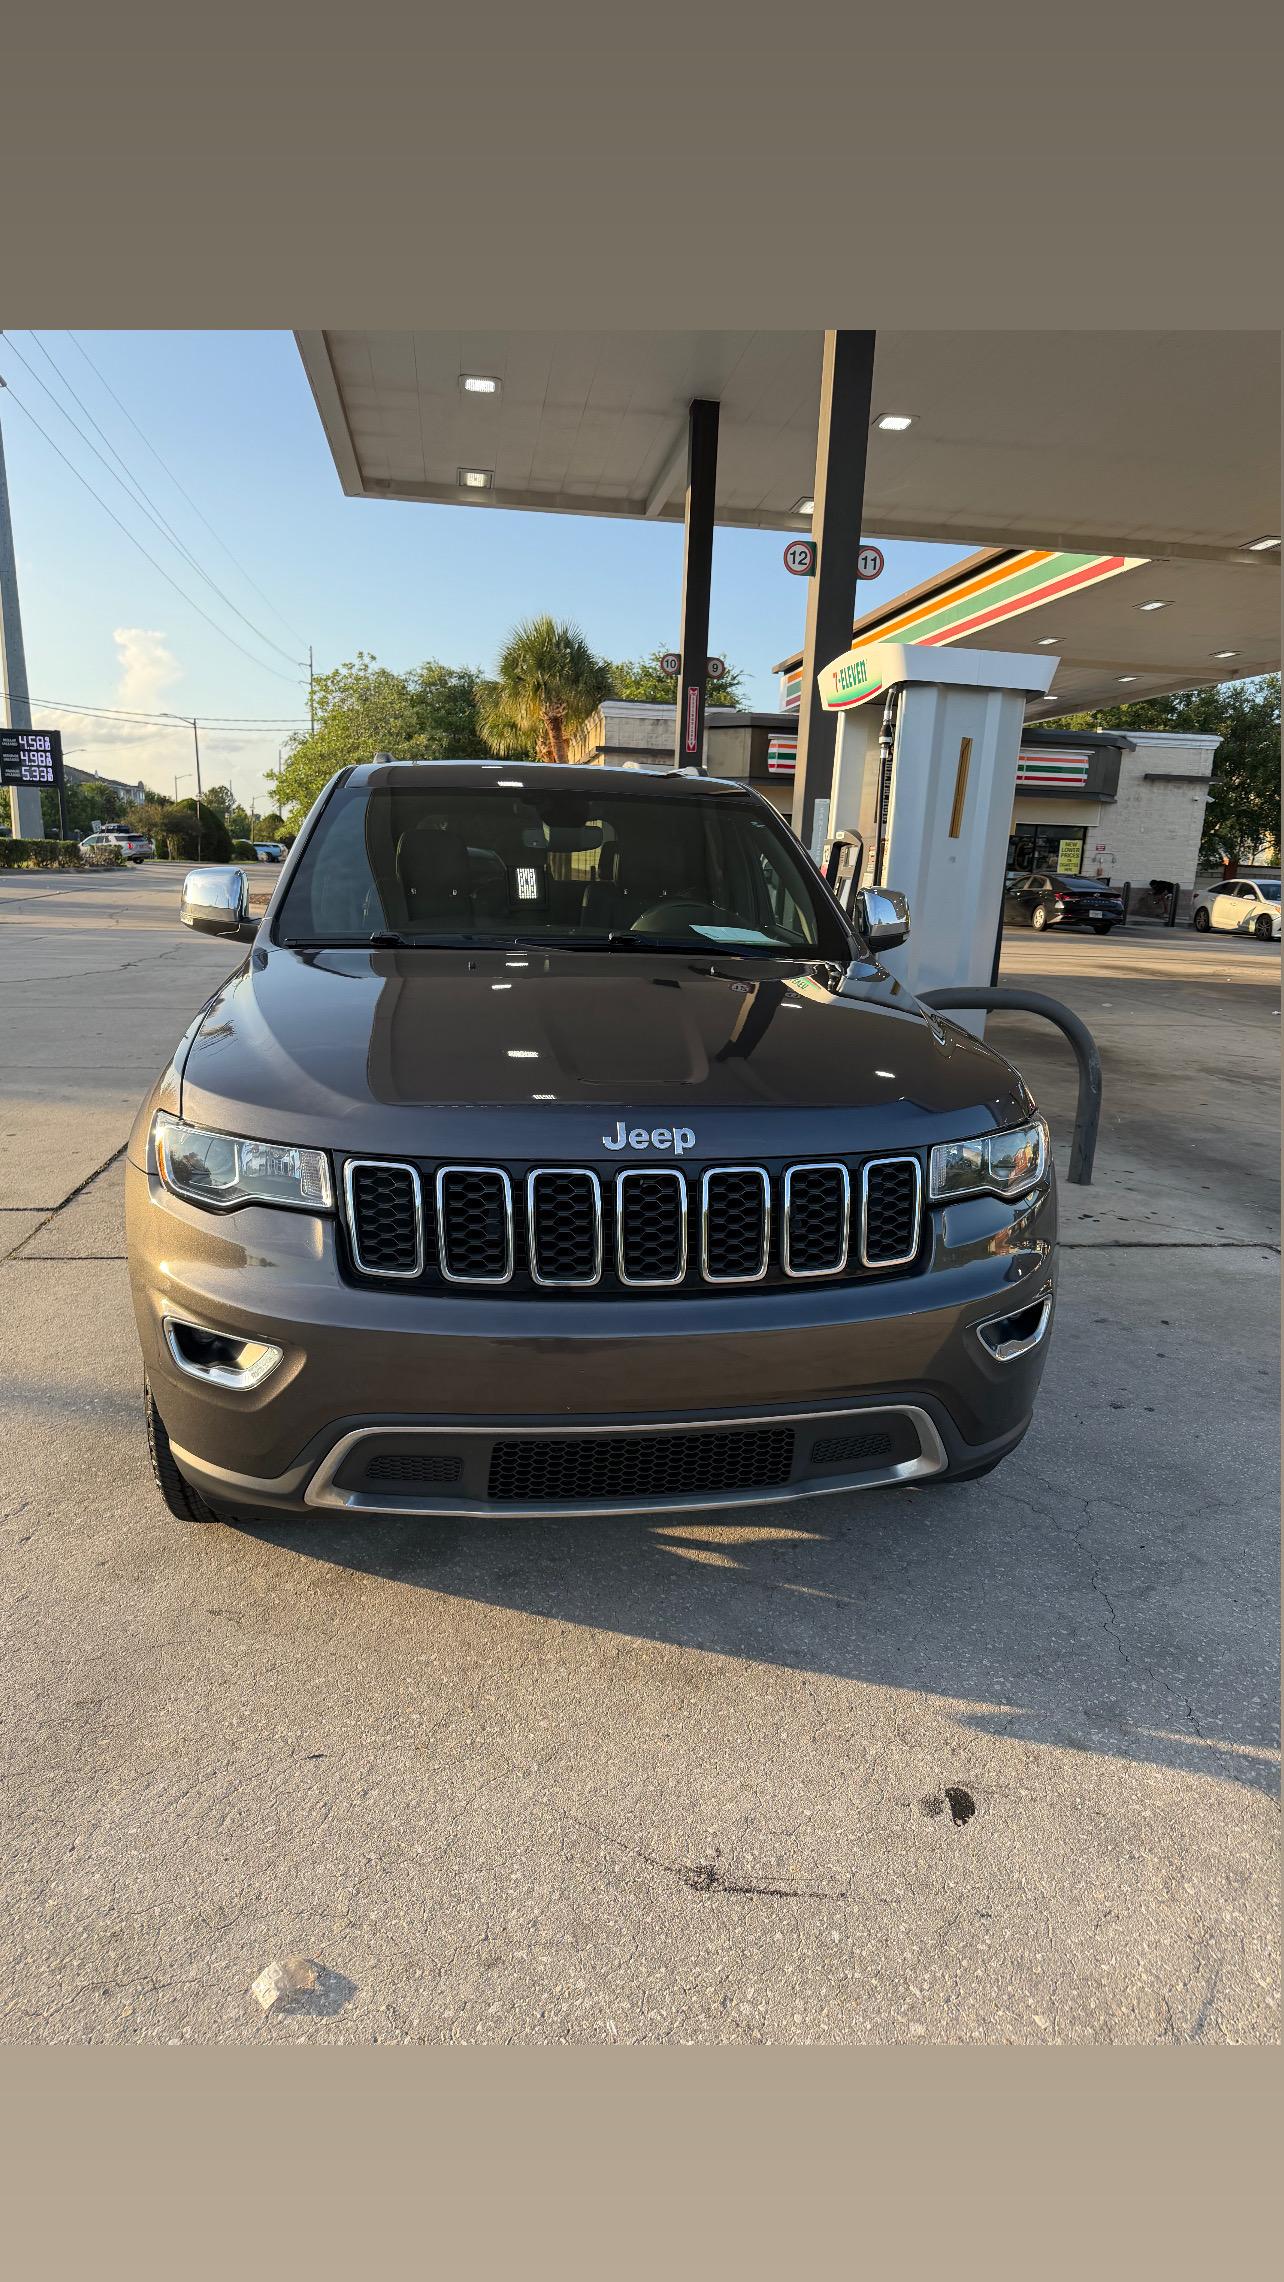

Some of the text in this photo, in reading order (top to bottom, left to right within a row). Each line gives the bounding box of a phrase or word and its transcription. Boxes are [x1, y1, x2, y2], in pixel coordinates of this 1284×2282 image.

[790, 550, 808, 565] 12
[861, 556, 877, 570] 11
[665, 659, 676, 669] 10
[712, 663, 718, 672] 9
[603, 1122, 695, 1154] Jeep
